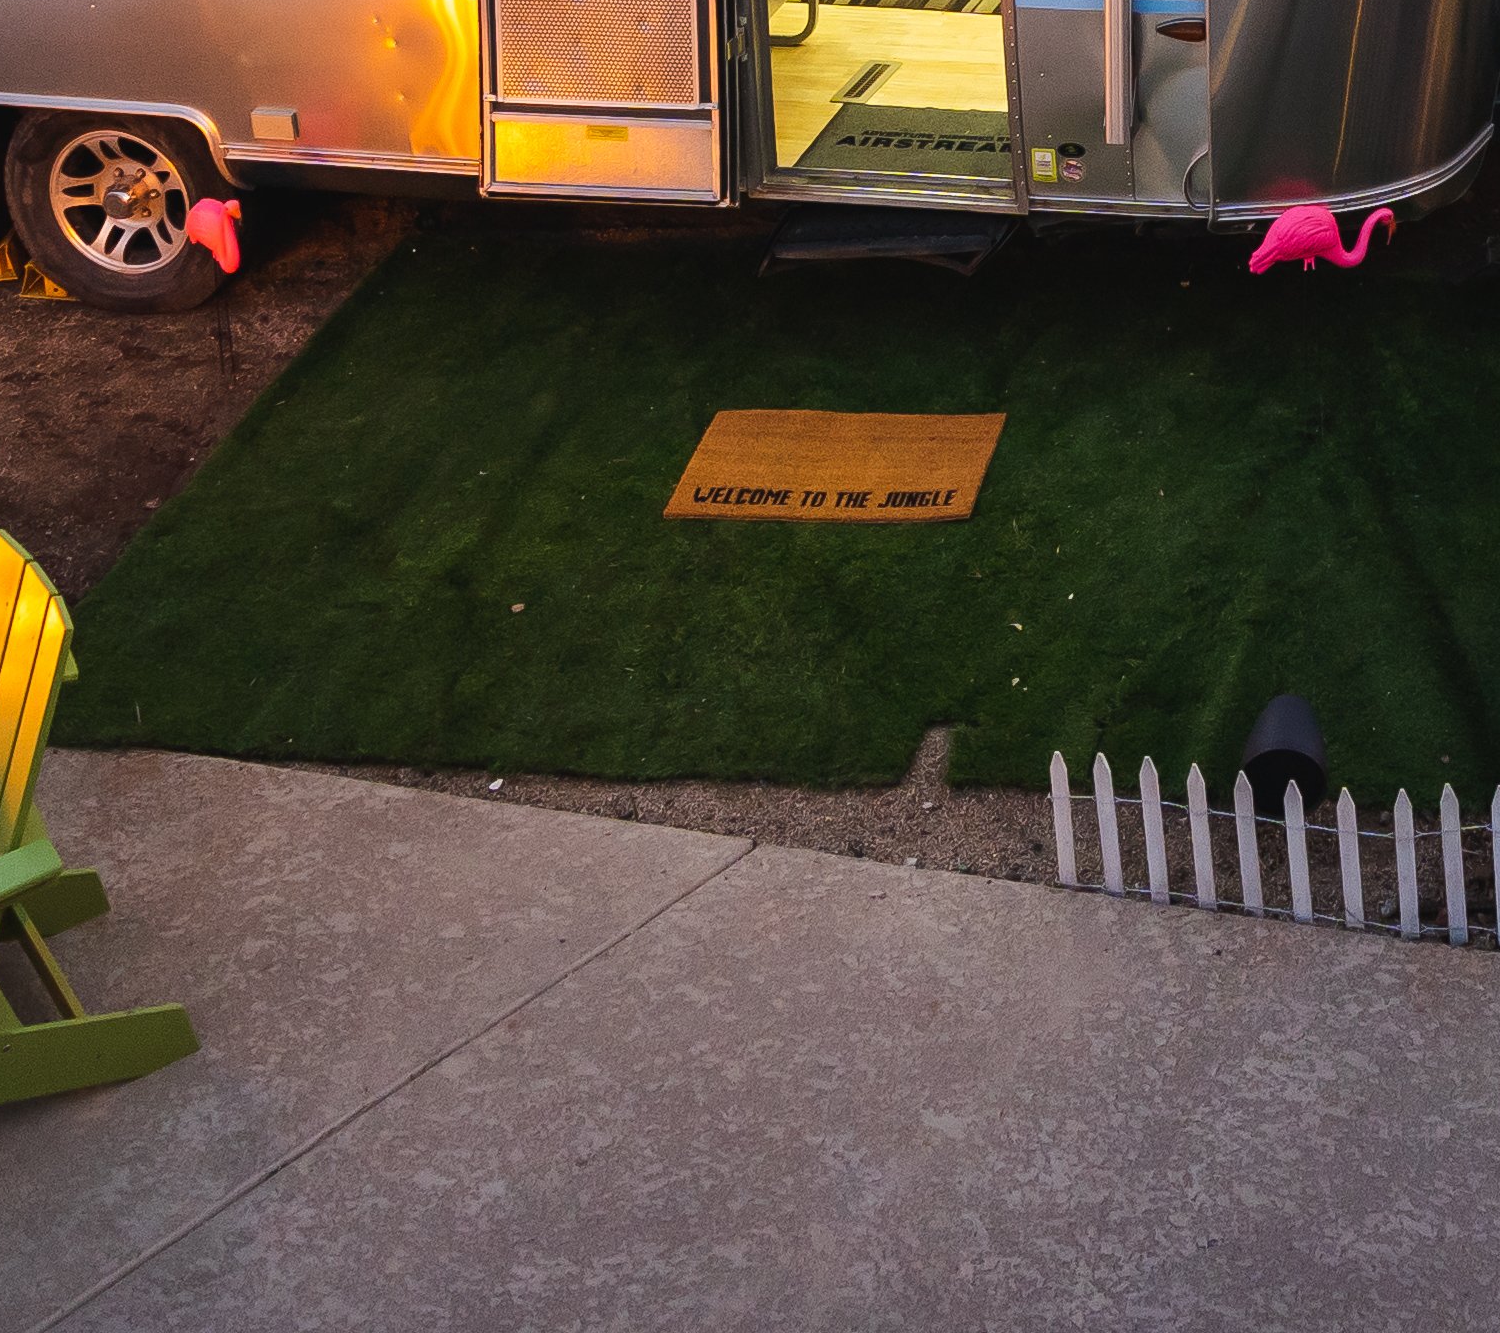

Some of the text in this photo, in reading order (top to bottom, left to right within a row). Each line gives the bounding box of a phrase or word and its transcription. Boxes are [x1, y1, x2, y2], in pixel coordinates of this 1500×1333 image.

[693, 486, 958, 509] WELCOME TO THE JUNGLE
